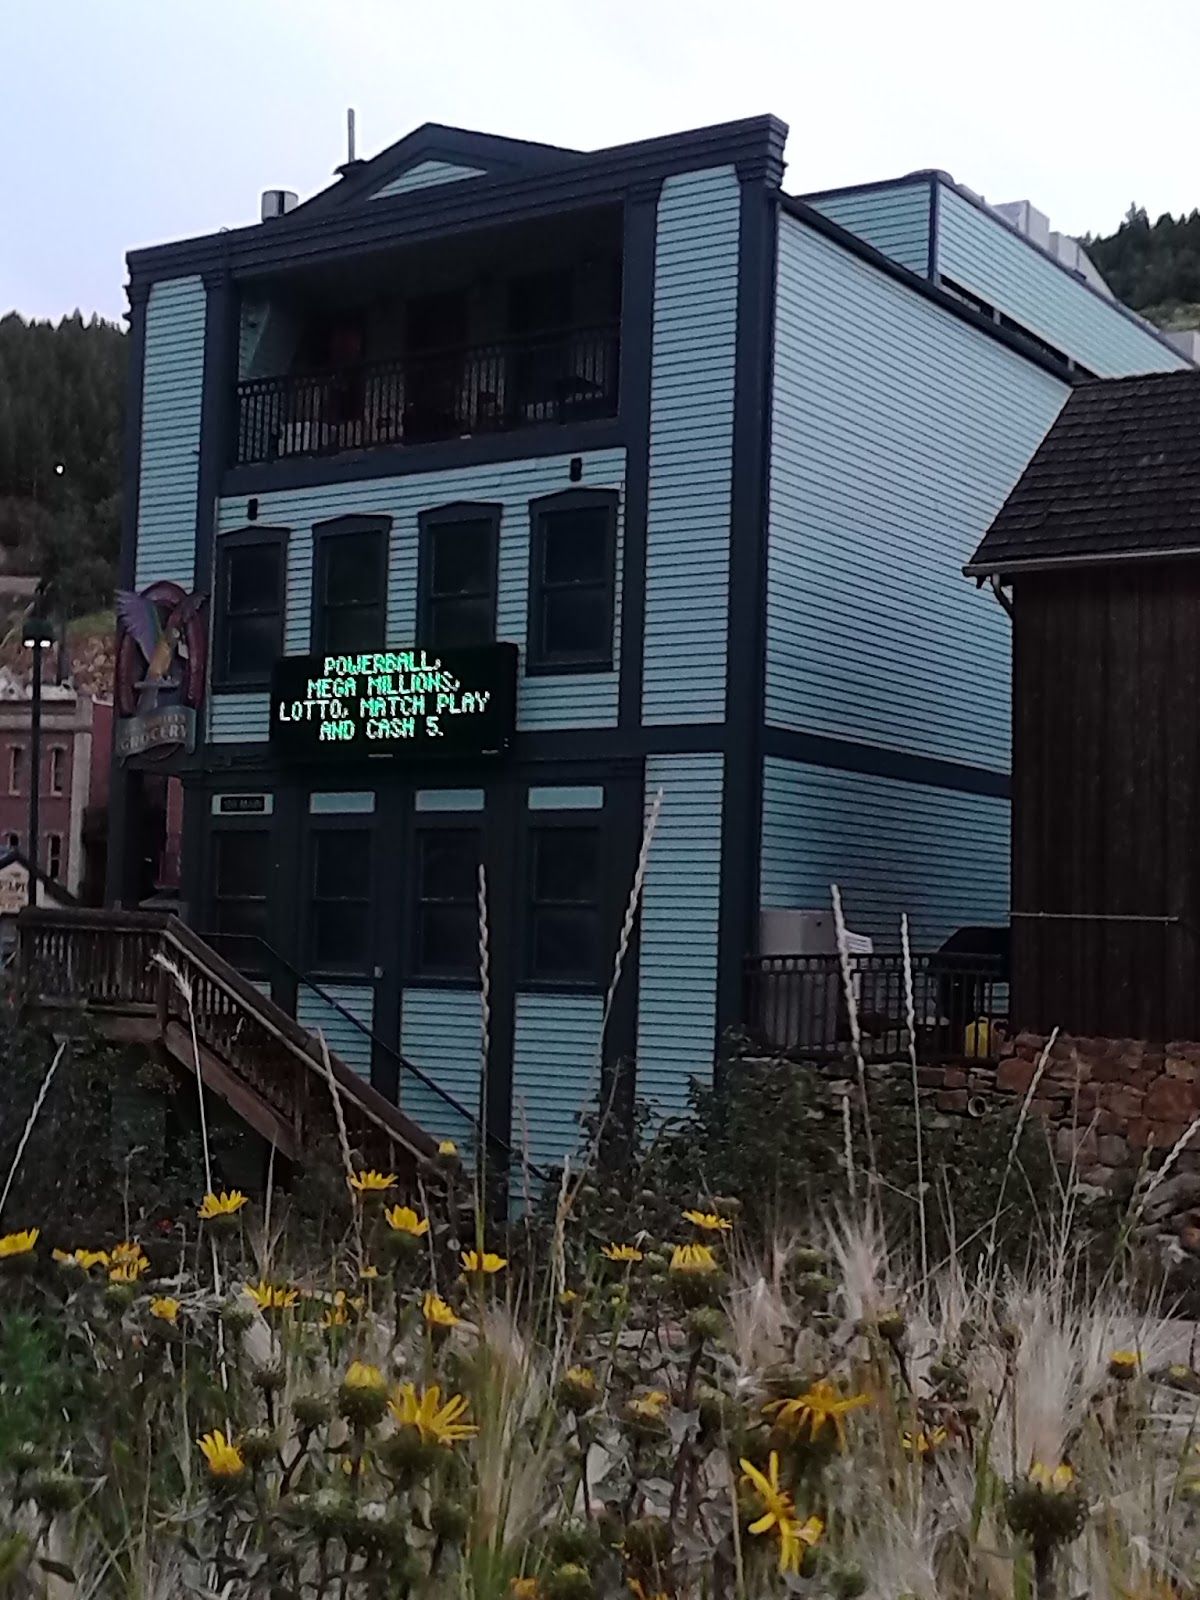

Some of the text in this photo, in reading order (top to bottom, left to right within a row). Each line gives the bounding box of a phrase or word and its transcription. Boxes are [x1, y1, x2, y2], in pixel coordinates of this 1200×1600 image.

[323, 650, 441, 677] POWERBALL,
[307, 677, 357, 700] MEGA
[279, 690, 490, 722] LOTTO, MATCH PLAY
[120, 724, 187, 750] GROCERY
[319, 719, 355, 741] AND
[366, 716, 416, 740] CASH
